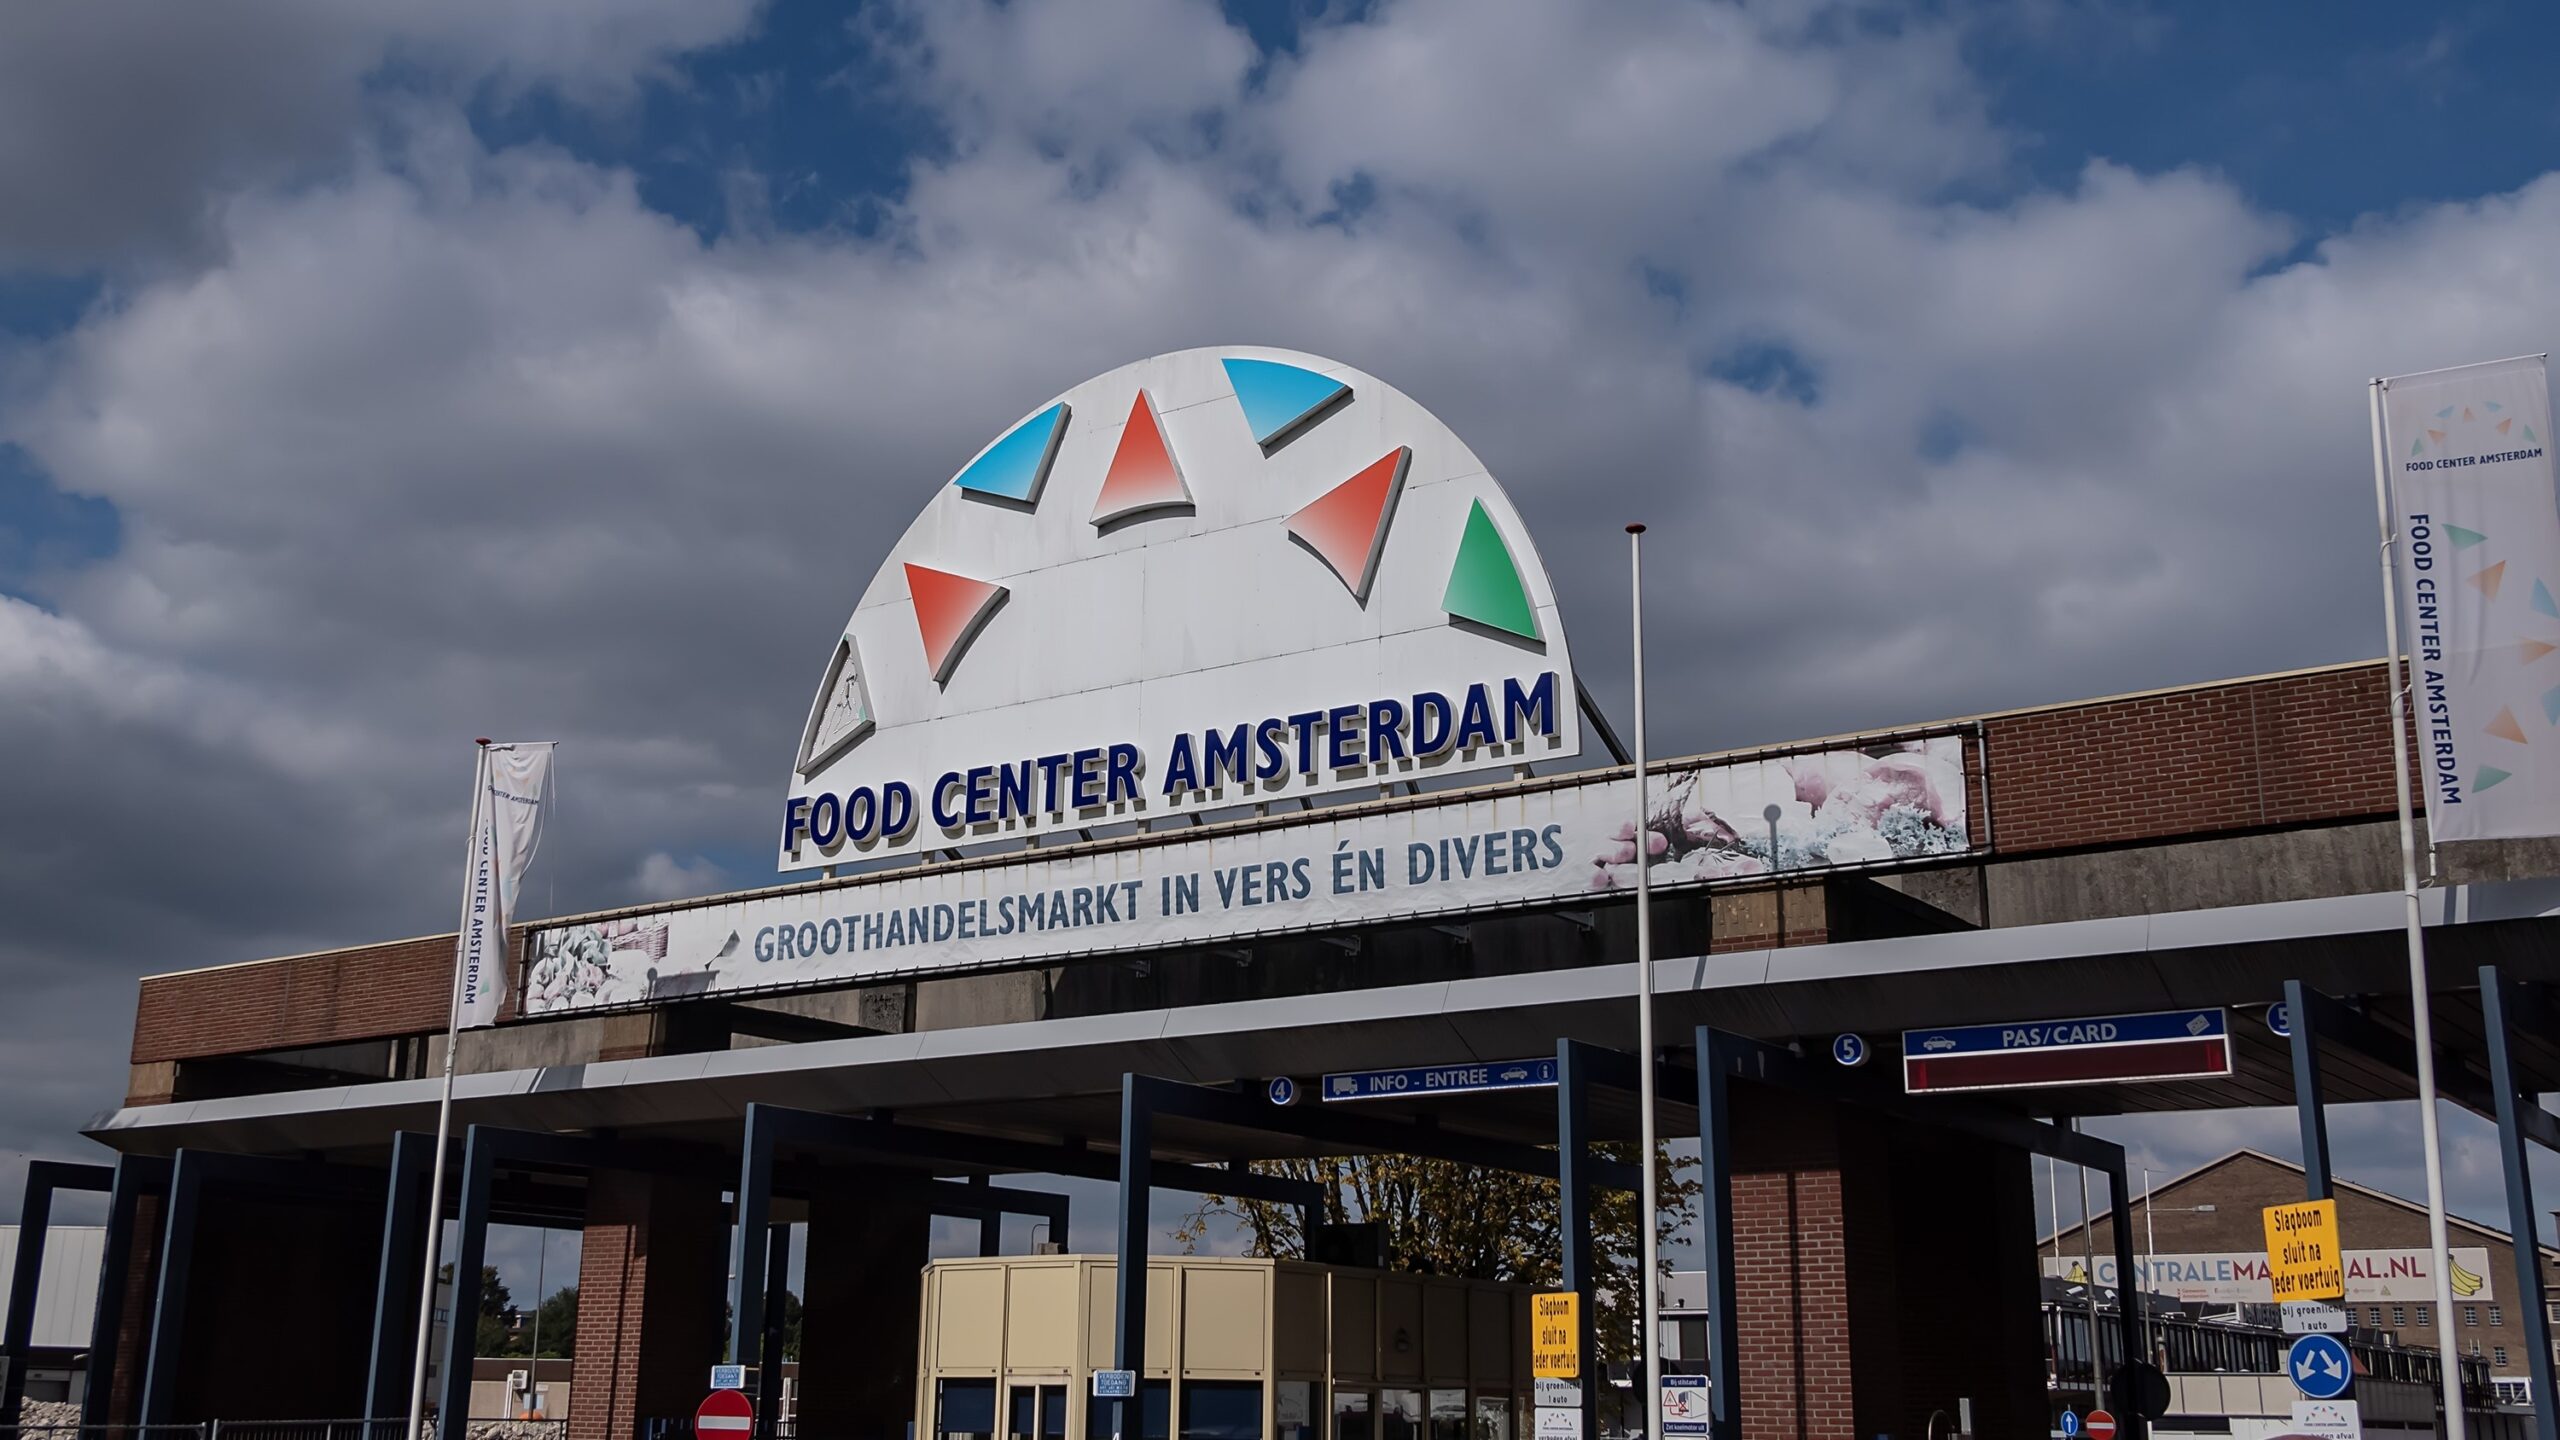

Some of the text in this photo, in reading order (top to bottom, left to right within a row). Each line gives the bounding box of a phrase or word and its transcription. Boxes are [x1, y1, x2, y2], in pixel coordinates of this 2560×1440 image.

[2405, 448, 2543, 472] FOOD CENTER AMSTERDAM
[2409, 514, 2462, 804] FOOD CENTER AMSTERDAM
[784, 671, 1558, 851] FOOD CENTER AMSTERDAM
[754, 824, 1564, 963] GROOTHANDELSMARKT IN VERS ÉN DIVERS
[464, 918, 484, 1005] AMSTERDAM
[2002, 1022, 2117, 1047] PAS/CARD
[1843, 1038, 1855, 1060] 5
[1275, 1081, 1286, 1099] 4
[1369, 1075, 1408, 1092] INFO
[1425, 1068, 1488, 1088] ENTREE
[2274, 1207, 2322, 1237] Slagboom
[2283, 1241, 2321, 1265] sluit na
[2270, 1270, 2295, 1295] ieder
[2297, 1264, 2341, 1294] voertuig
[1539, 1296, 1569, 1322] Slagboom
[2282, 1306, 2294, 1318] bij
[1542, 1325, 1567, 1345] sluit na
[2307, 1320, 2328, 1330] auto
[1549, 1348, 1576, 1375] voertuig
[1535, 1381, 1545, 1392] bij
[1552, 1395, 1568, 1403] auto
